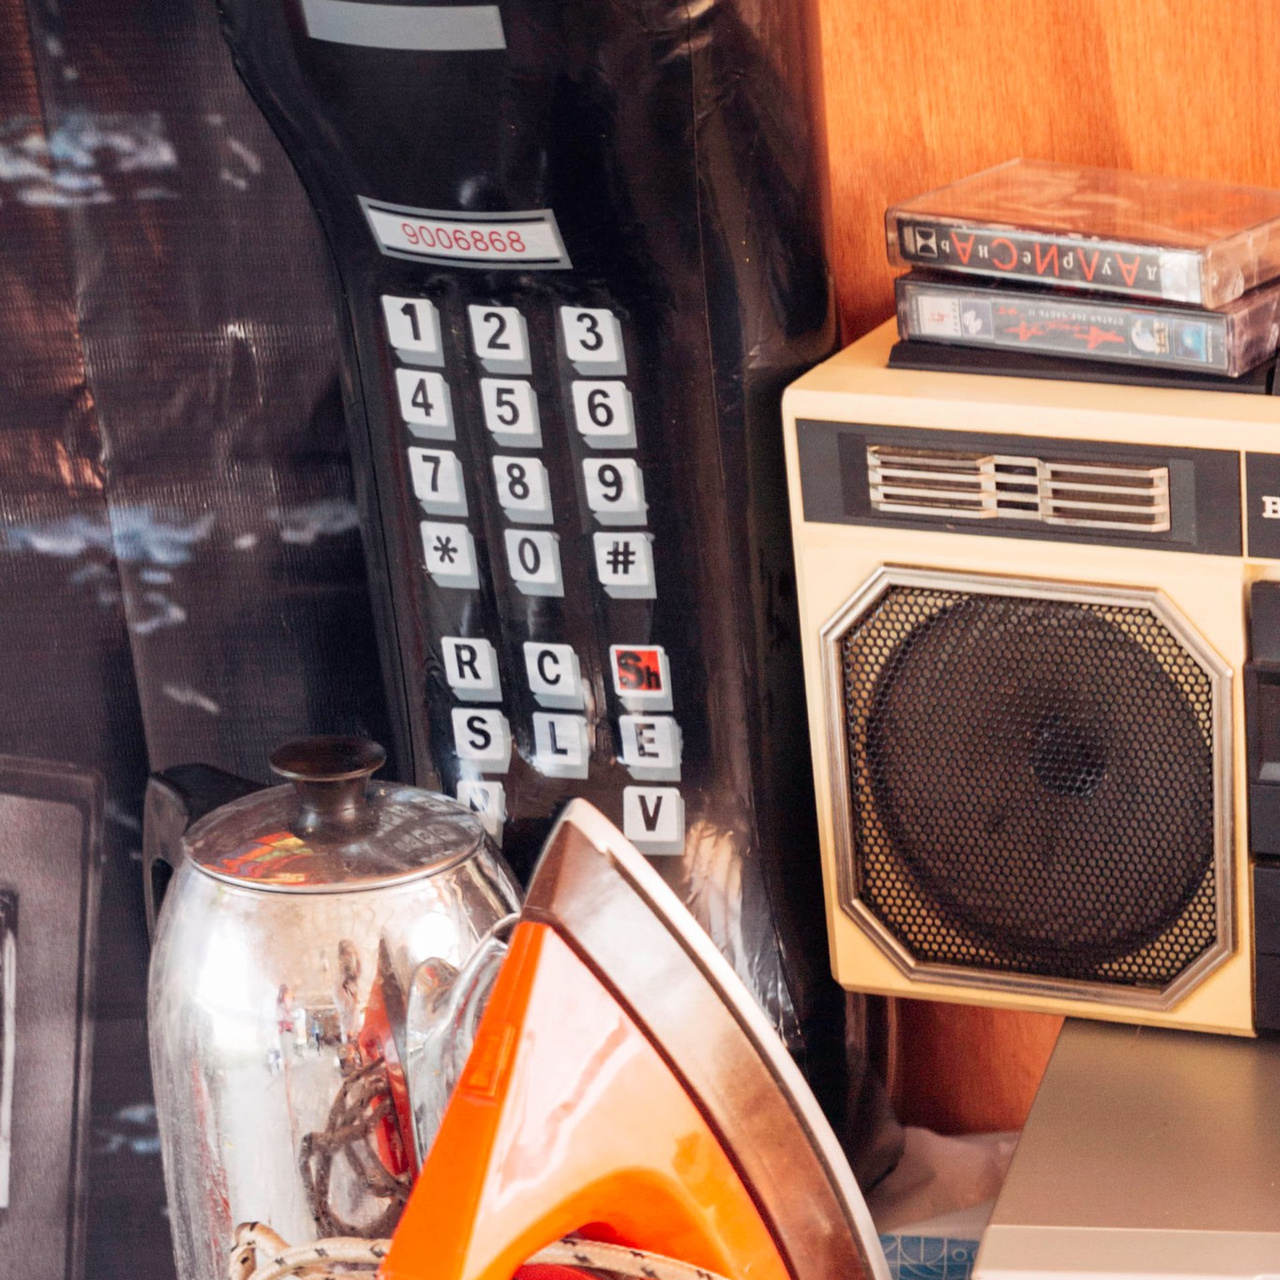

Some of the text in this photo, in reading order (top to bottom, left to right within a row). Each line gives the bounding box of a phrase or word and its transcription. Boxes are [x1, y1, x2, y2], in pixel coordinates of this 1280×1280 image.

[401, 222, 527, 253] 9006868
[400, 303, 604, 351] 1 2 3
[411, 378, 614, 427] 4 5 6
[421, 454, 624, 503] 7 8 9
[518, 537, 541, 575] 0
[454, 643, 662, 691] R C Sh
[466, 715, 660, 759] S L E
[638, 794, 663, 832] V
